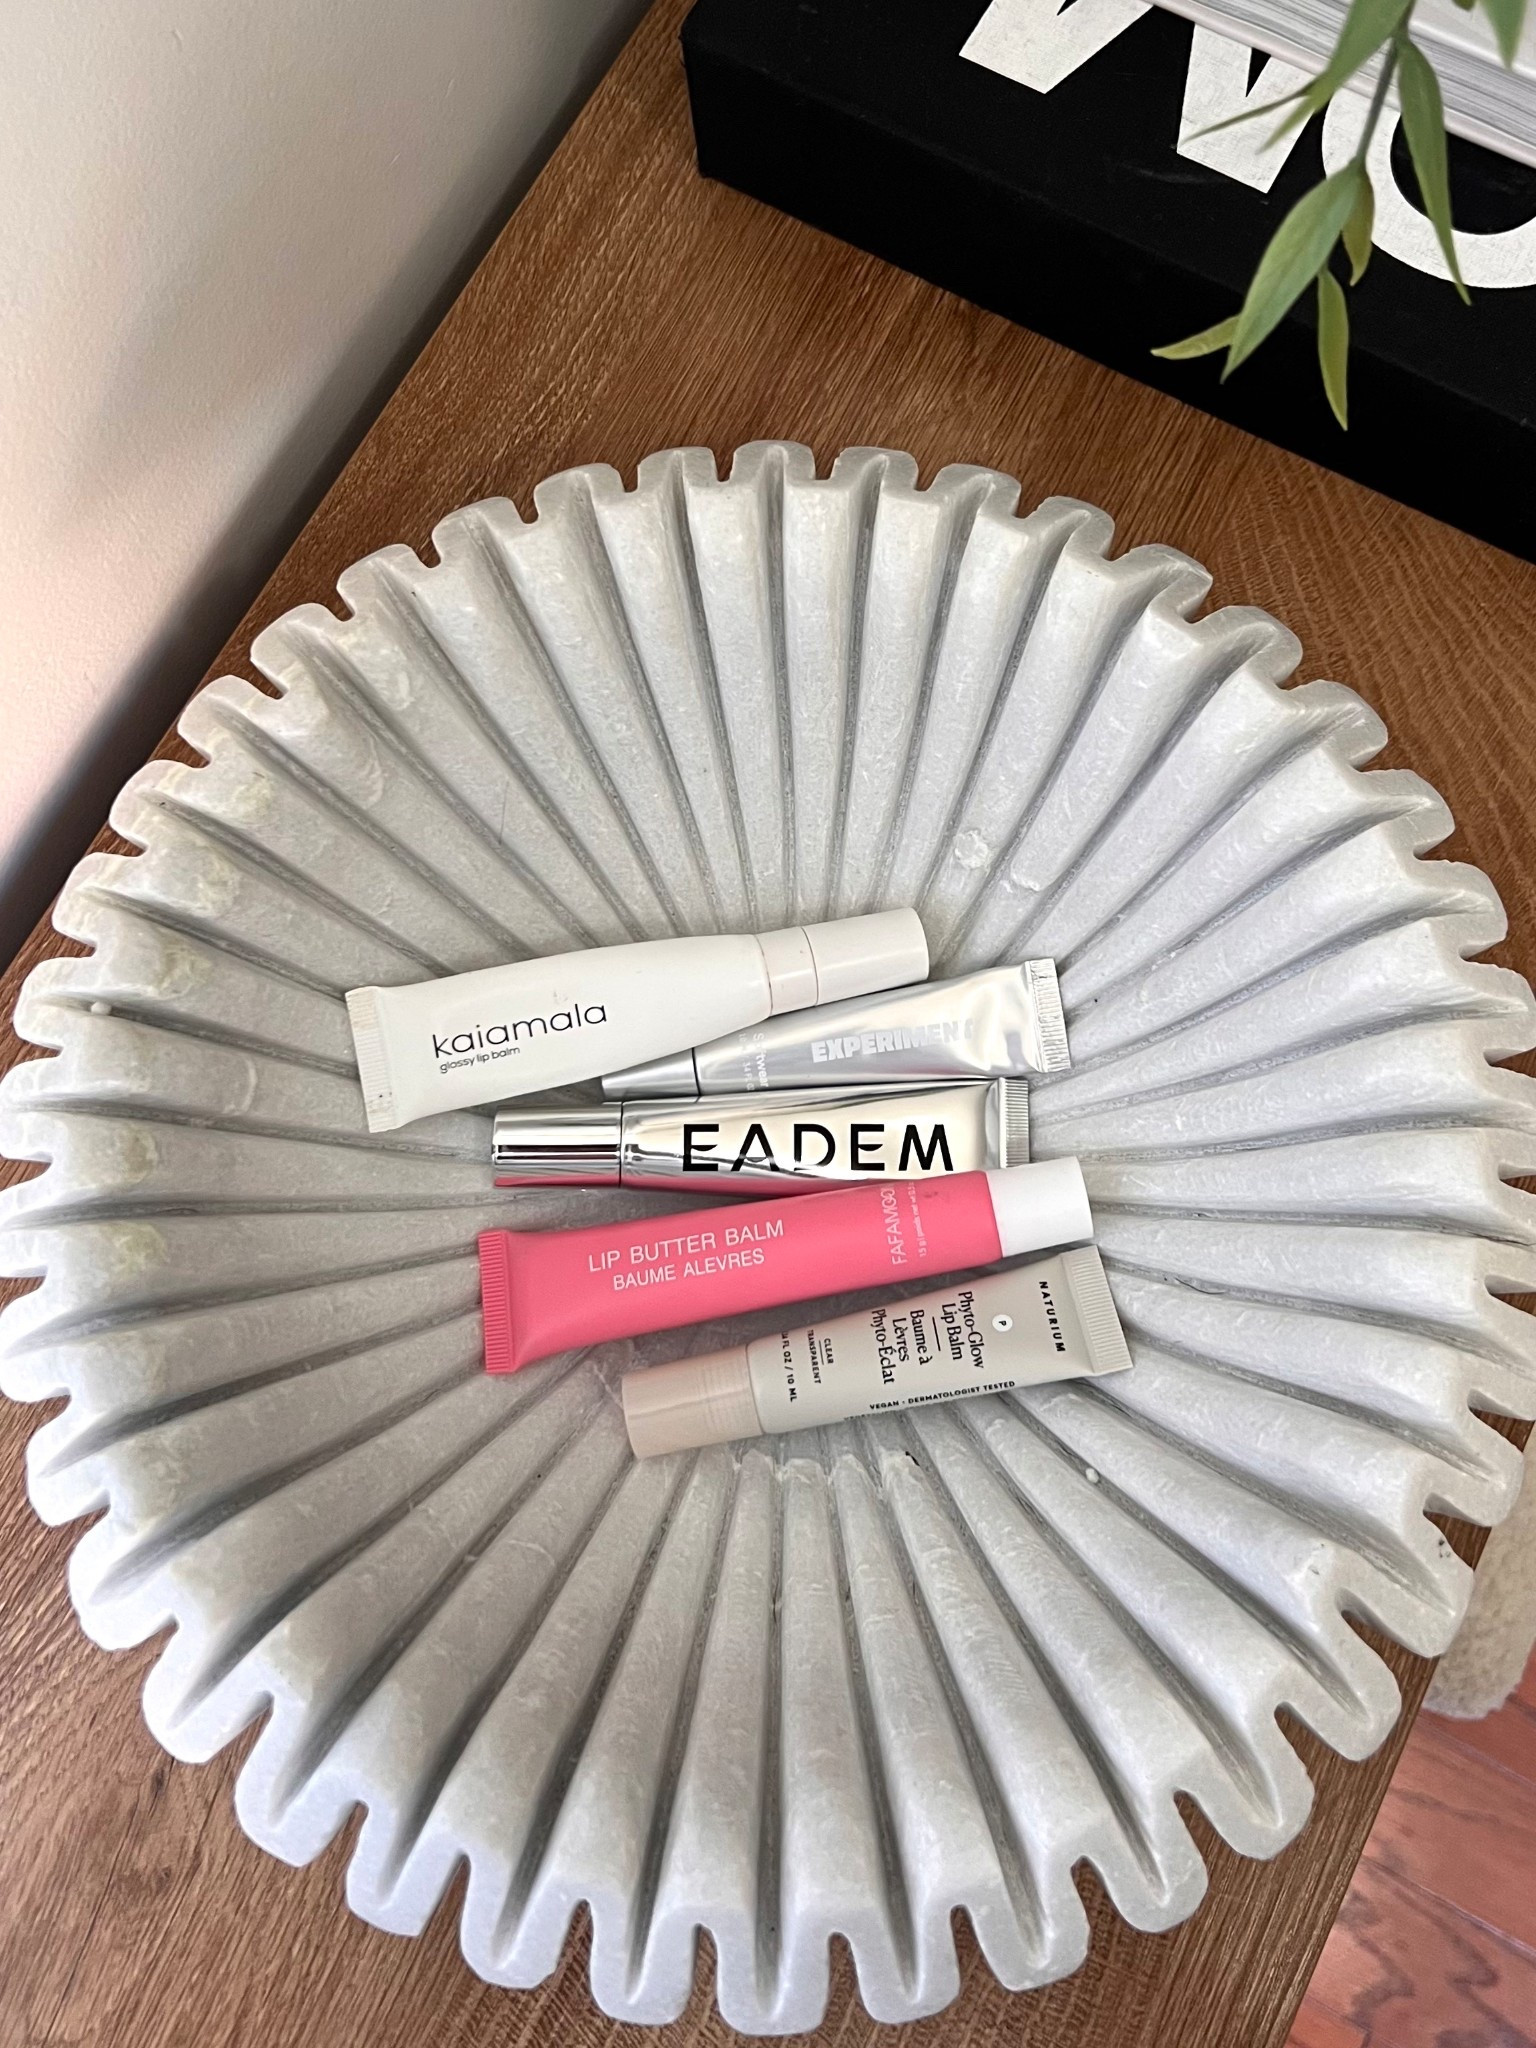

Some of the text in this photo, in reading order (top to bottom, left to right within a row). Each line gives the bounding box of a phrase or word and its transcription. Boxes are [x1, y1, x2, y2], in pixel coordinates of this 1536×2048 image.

[432, 1003, 607, 1059] kaiamala
[440, 1046, 520, 1074] glossy lip balm
[753, 1032, 769, 1088] Stwear
[682, 1124, 954, 1172] EADEM
[588, 1219, 784, 1272] LIP BUTTER BALM
[613, 1248, 765, 1290] BAUME ALEVRES
[892, 1317, 910, 1362] Lèvres
[910, 1309, 933, 1366] Baume à
[940, 1303, 965, 1360] Lip Balm
[958, 1291, 985, 1369] Phyto-Glow
[1039, 1281, 1066, 1352] NATURIUM
[783, 1350, 792, 1363] OZ
[807, 1329, 821, 1384] TRANSPARENT
[824, 1338, 834, 1364] CLEAR
[870, 1308, 897, 1385] Phyto-Éclat
[786, 1373, 795, 1385] 10
[788, 1387, 798, 1403] ML
[869, 1380, 1016, 1410] VEGAN DERMATOLOGIST TESTED
